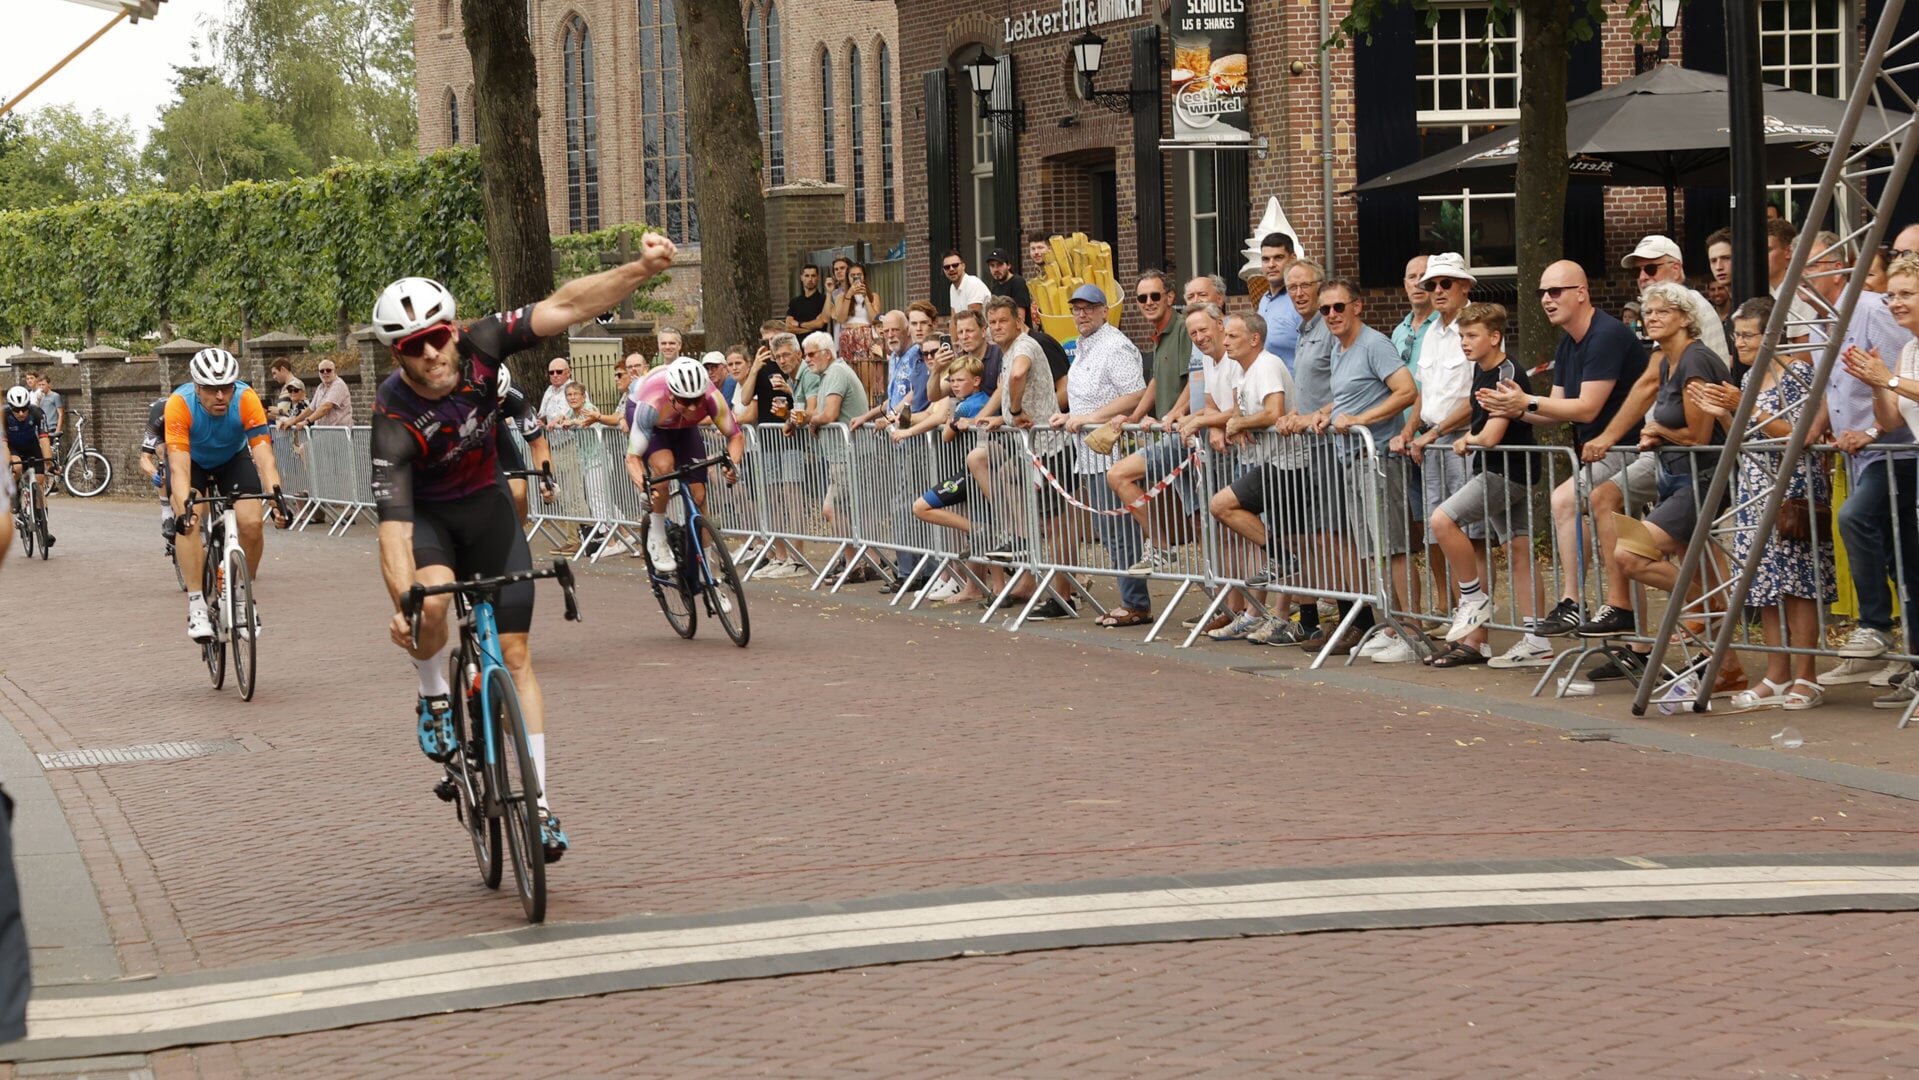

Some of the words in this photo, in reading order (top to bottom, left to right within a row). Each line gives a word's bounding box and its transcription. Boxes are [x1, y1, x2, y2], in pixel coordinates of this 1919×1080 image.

[1187, 0, 1245, 14] SCHOTELS
[1004, 9, 1061, 43] Lekker
[1061, 0, 1086, 32] ETEN
[1087, 1, 1098, 27] &
[1195, 18, 1202, 31] &
[1203, 17, 1235, 30] SHAKES
[1183, 89, 1209, 103] eet
[1189, 98, 1241, 114] winkel
